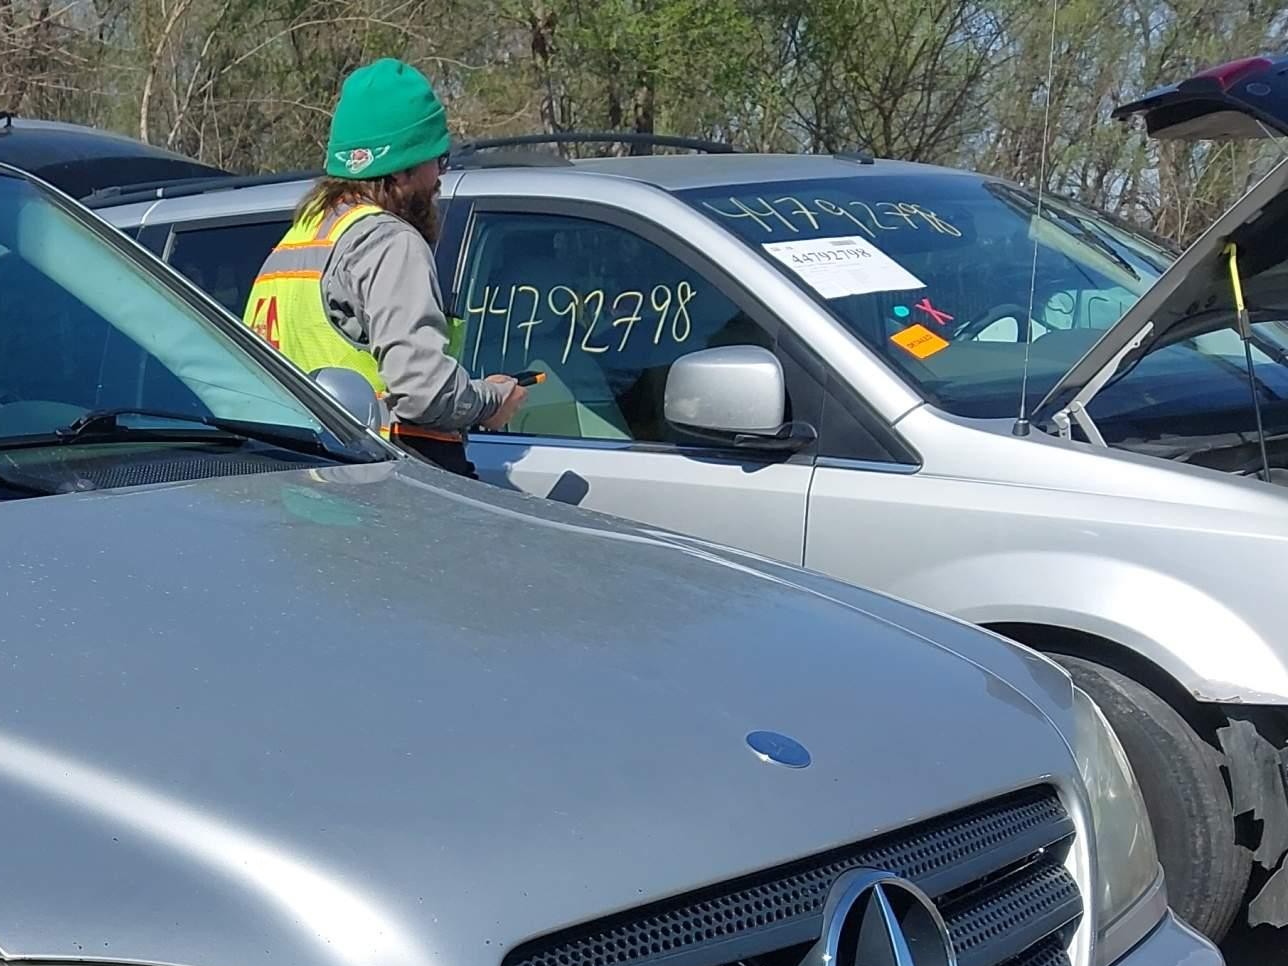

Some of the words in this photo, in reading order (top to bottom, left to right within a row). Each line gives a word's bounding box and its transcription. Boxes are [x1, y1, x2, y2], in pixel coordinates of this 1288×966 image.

[701, 196, 962, 238] 44792798
[791, 248, 872, 265] 44792798
[466, 280, 697, 372] 44792798
